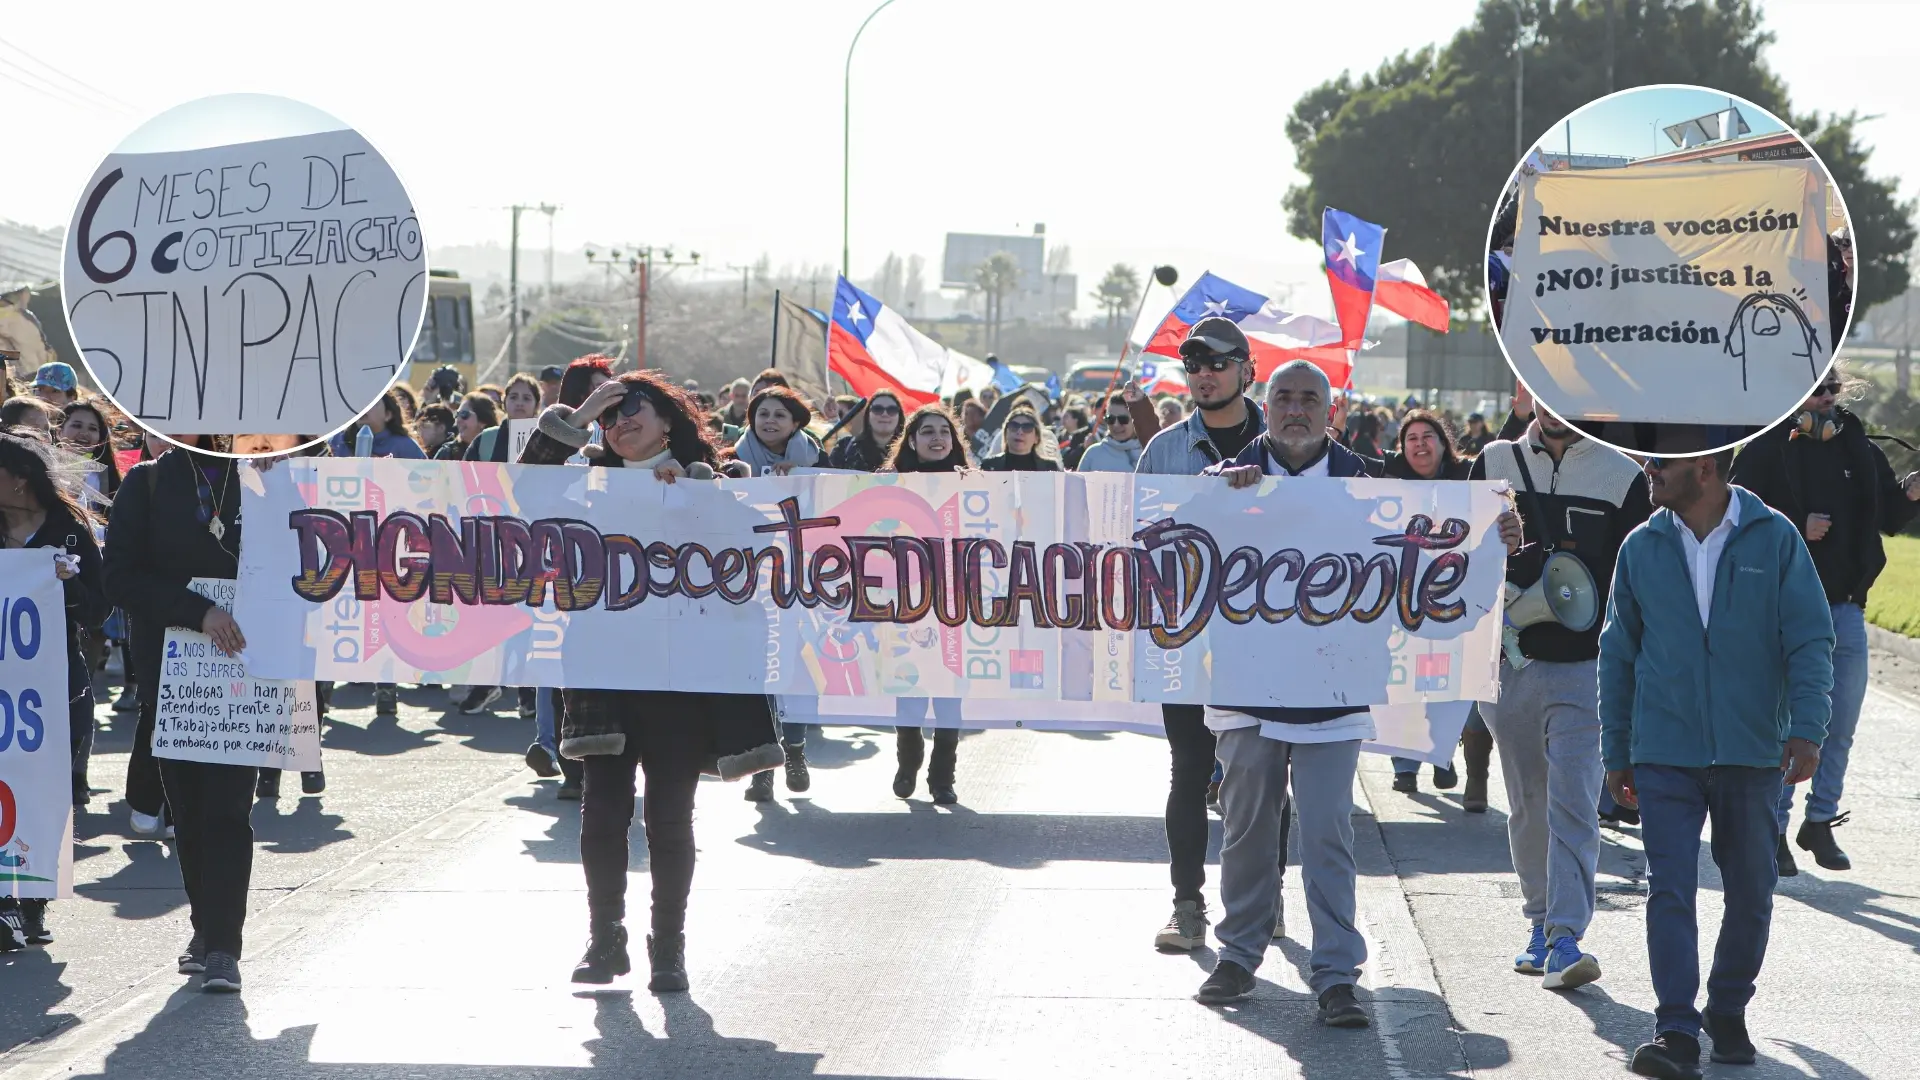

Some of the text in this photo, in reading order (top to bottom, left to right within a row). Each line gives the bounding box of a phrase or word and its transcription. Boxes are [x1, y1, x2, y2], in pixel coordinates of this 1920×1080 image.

[77, 152, 368, 284] 6 MESES DE
[1538, 209, 1799, 237] Nuestra vocación
[1535, 263, 1773, 297] ¡NO! justifica la
[1531, 321, 1721, 345] vulneración
[289, 508, 605, 611] DIGNIDAD
[167, 640, 182, 659] 2.
[184, 642, 205, 658] NOS
[196, 662, 245, 679] ISAPRES
[161, 684, 175, 700] 3.
[230, 682, 246, 698] NO
[254, 682, 277, 698] han
[256, 719, 276, 734] han
[156, 736, 169, 748] de
